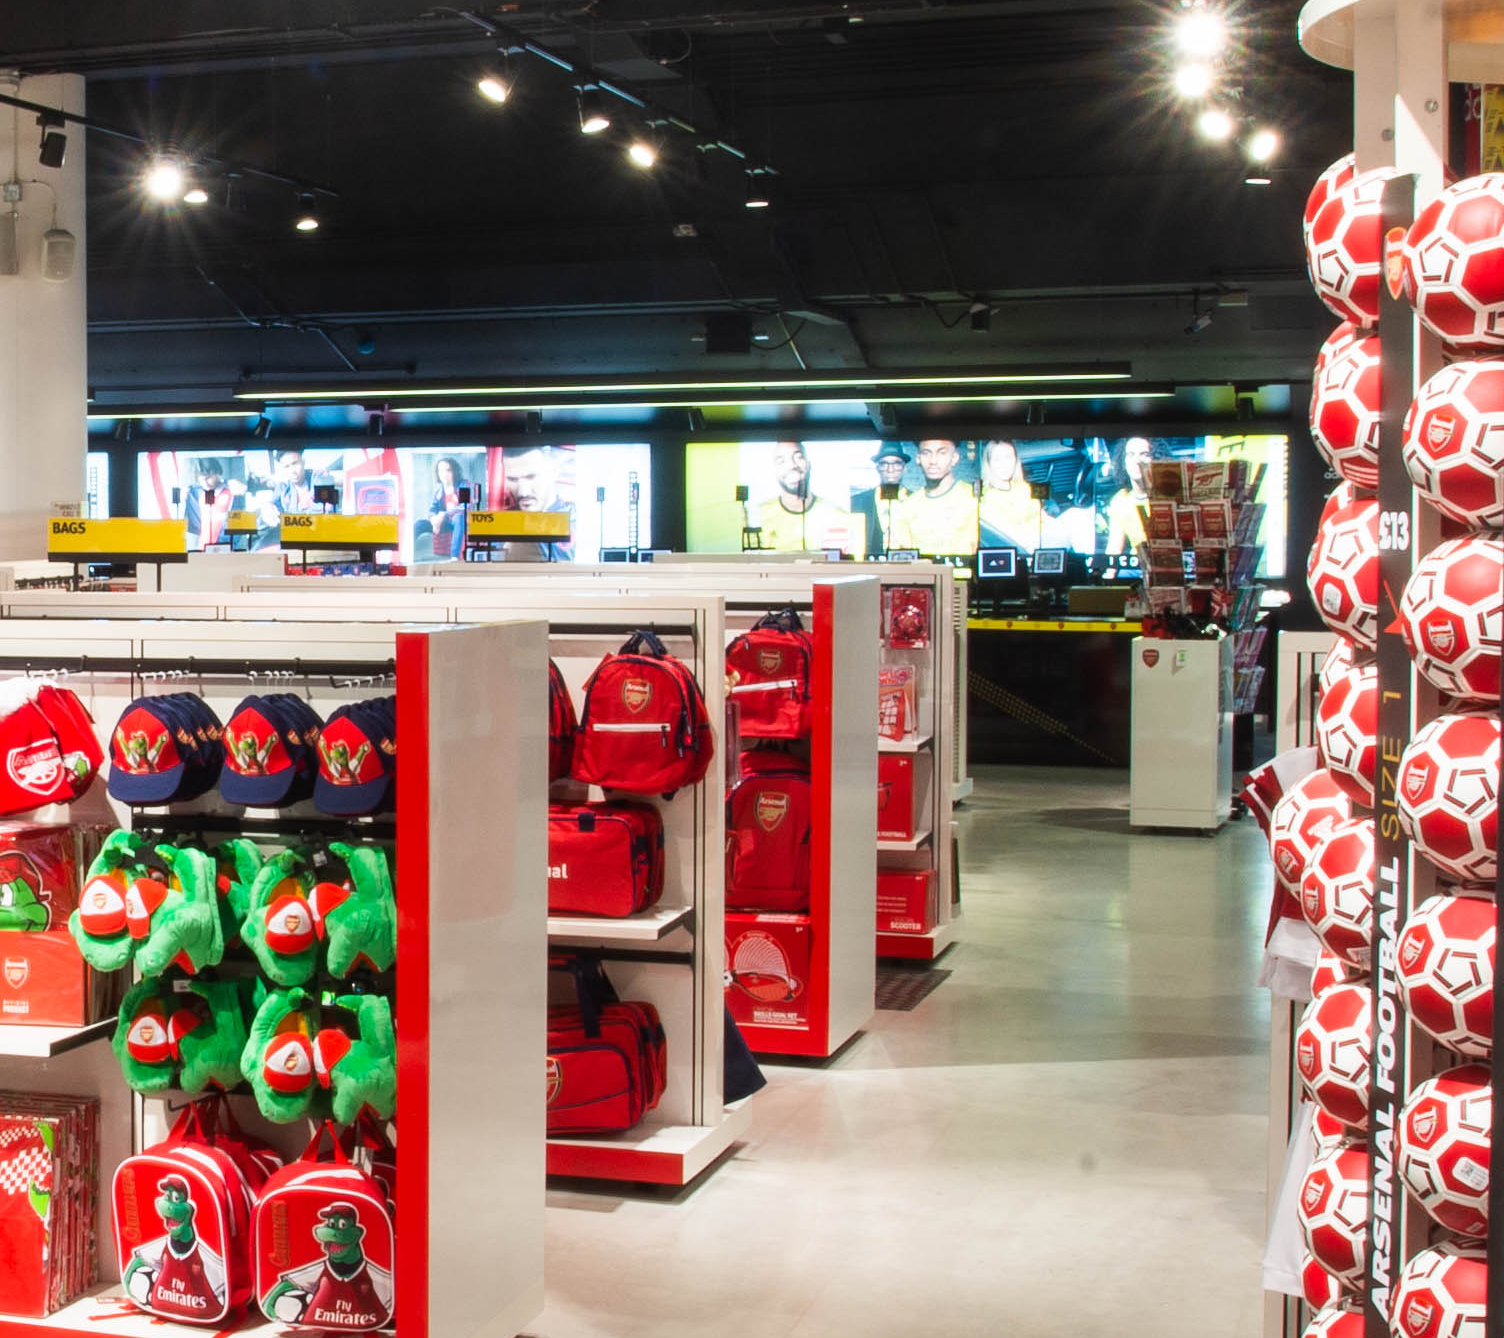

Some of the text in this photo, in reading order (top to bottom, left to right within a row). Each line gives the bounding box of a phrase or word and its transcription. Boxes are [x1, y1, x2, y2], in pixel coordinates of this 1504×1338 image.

[283, 514, 313, 527] BAGS
[471, 511, 495, 524] TOYS
[52, 521, 87, 535] BAGS
[1379, 510, 1410, 551] £13
[1381, 734, 1402, 842] SIZE
[1371, 856, 1401, 1323] ARSENAL FOOTBALL
[171, 1277, 186, 1292] Fly
[156, 1288, 208, 1310] Emirates
[336, 1299, 352, 1312] Fly
[314, 1308, 377, 1326] Emirates
